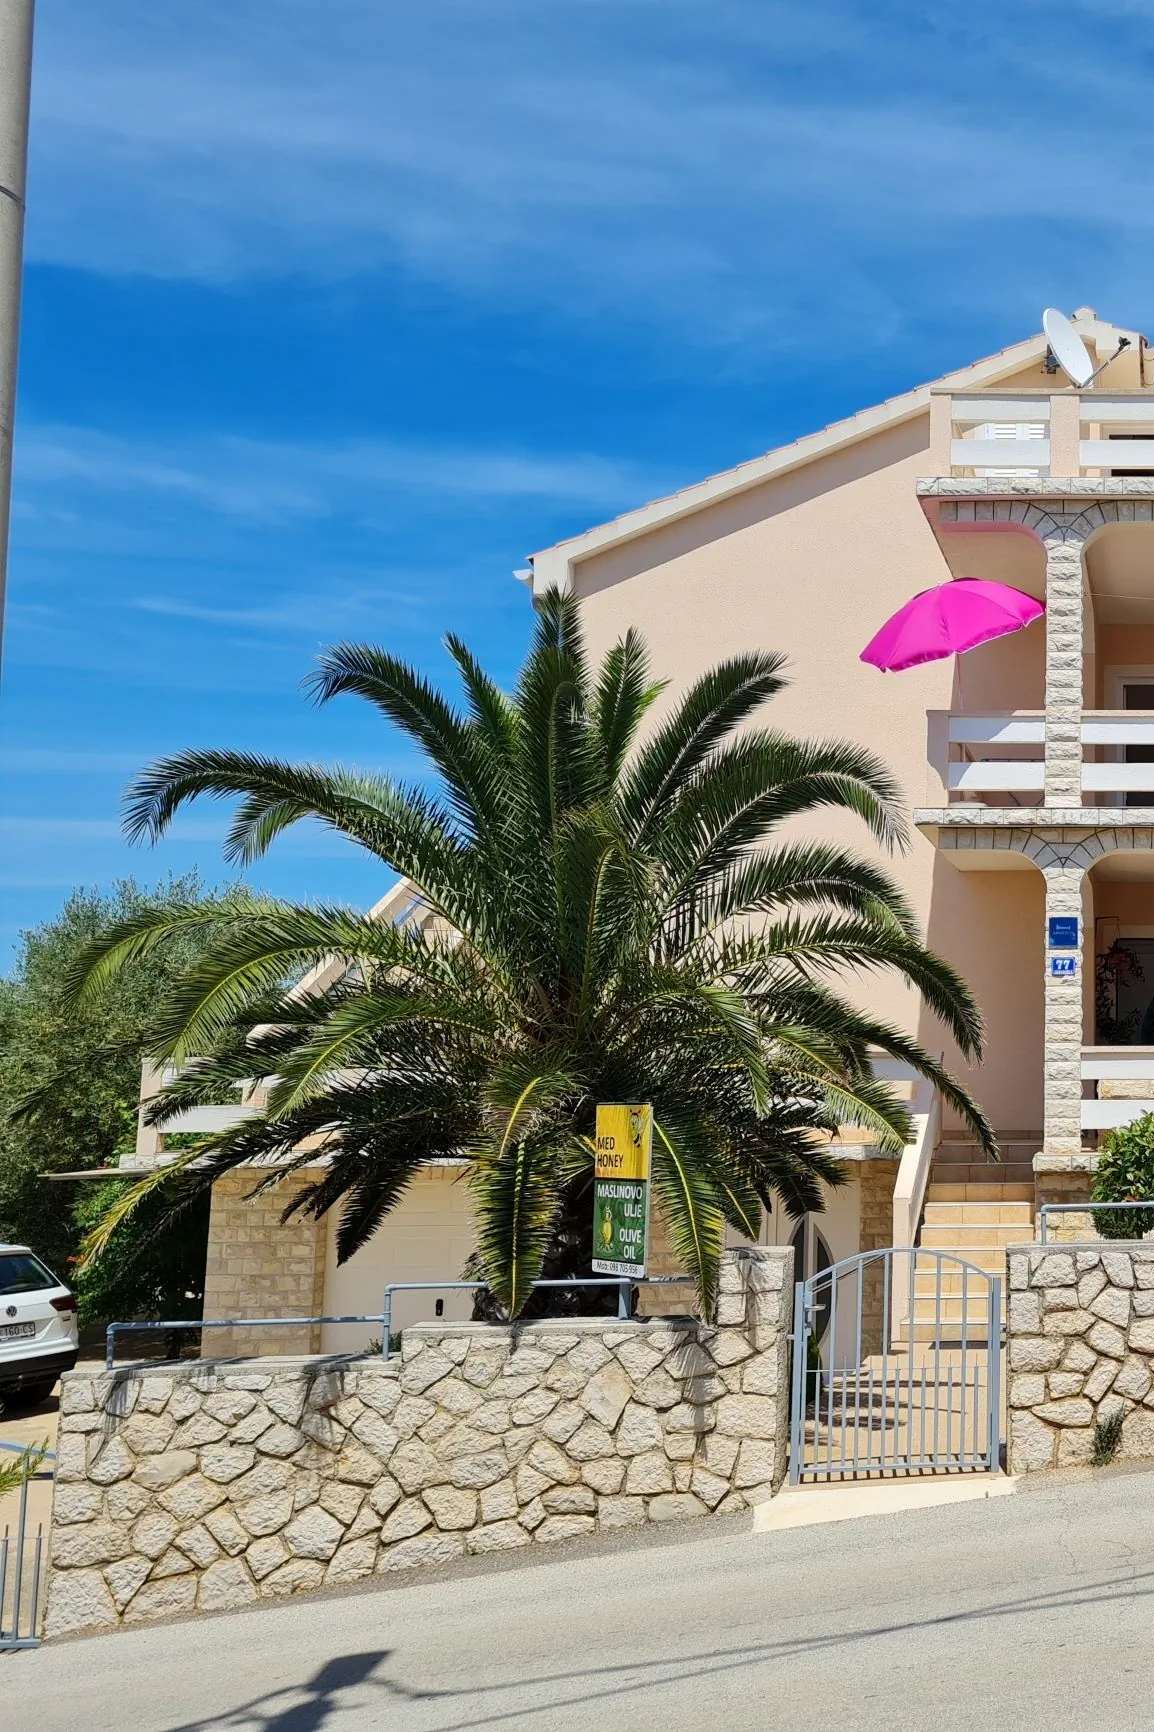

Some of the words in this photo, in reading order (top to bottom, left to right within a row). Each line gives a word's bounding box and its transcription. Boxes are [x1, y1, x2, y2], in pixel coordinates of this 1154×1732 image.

[1056, 959, 1071, 970] 77
[597, 1136, 615, 1151] MED
[596, 1154, 624, 1168] HONEY
[597, 1184, 643, 1200] MASLINOVO
[624, 1203, 642, 1218] ULJE
[619, 1228, 642, 1244] OLIVE
[623, 1245, 636, 1260] OIL
